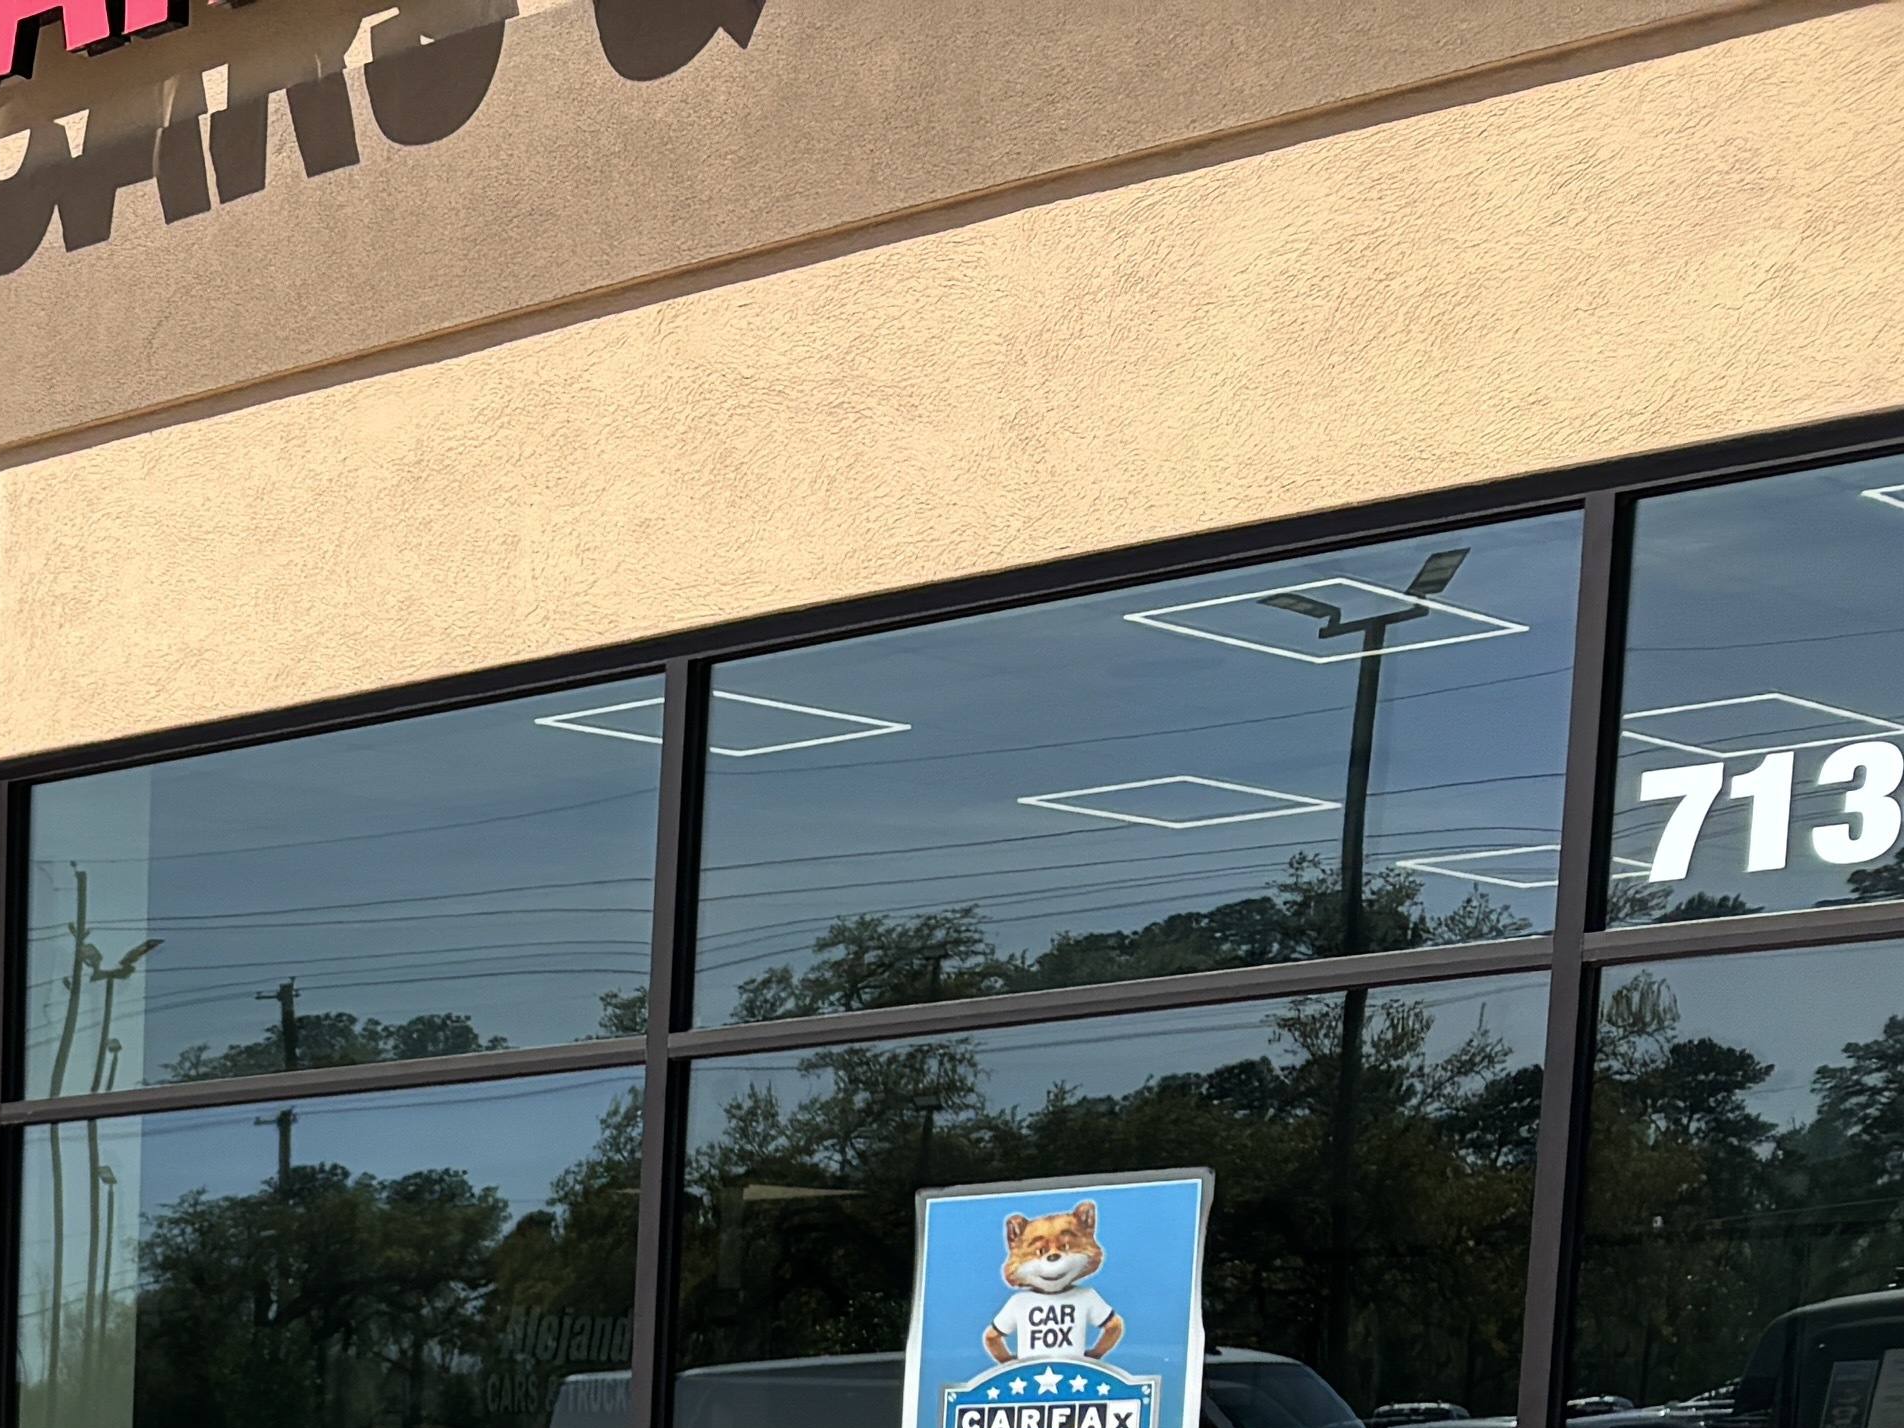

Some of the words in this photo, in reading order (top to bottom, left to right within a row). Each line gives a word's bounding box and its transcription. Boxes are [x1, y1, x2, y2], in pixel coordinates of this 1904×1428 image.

[1639, 740, 1904, 883] 713
[1028, 1305, 1075, 1327] CAR
[1030, 1327, 1073, 1349] FOX
